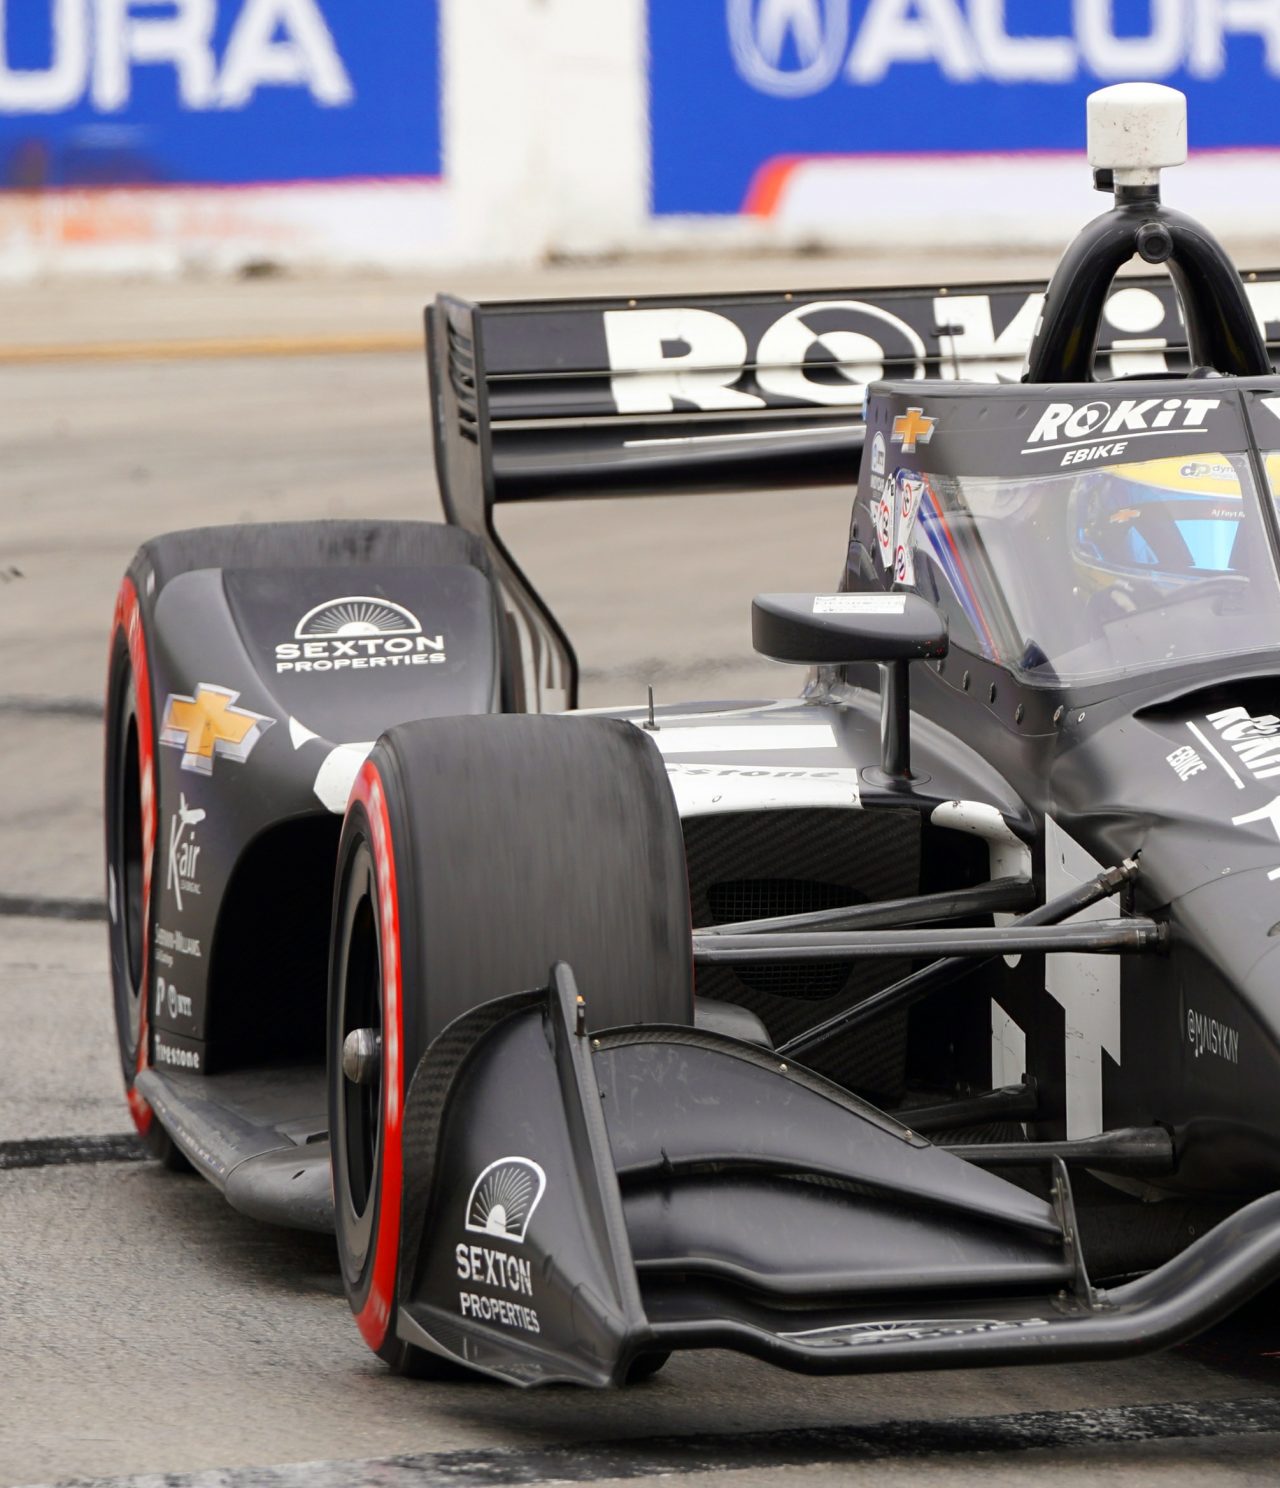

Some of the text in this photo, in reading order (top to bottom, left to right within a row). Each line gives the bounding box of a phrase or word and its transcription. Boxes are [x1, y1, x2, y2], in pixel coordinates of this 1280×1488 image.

[1060, 442, 1128, 467] EBIKE
[275, 635, 444, 660] SEXTON
[276, 653, 446, 673] PROPERTIES
[667, 767, 839, 778] stone
[1165, 745, 1207, 782] EBIKE
[456, 1243, 533, 1297] SEXTON
[460, 1292, 540, 1333] PROPERTIES
